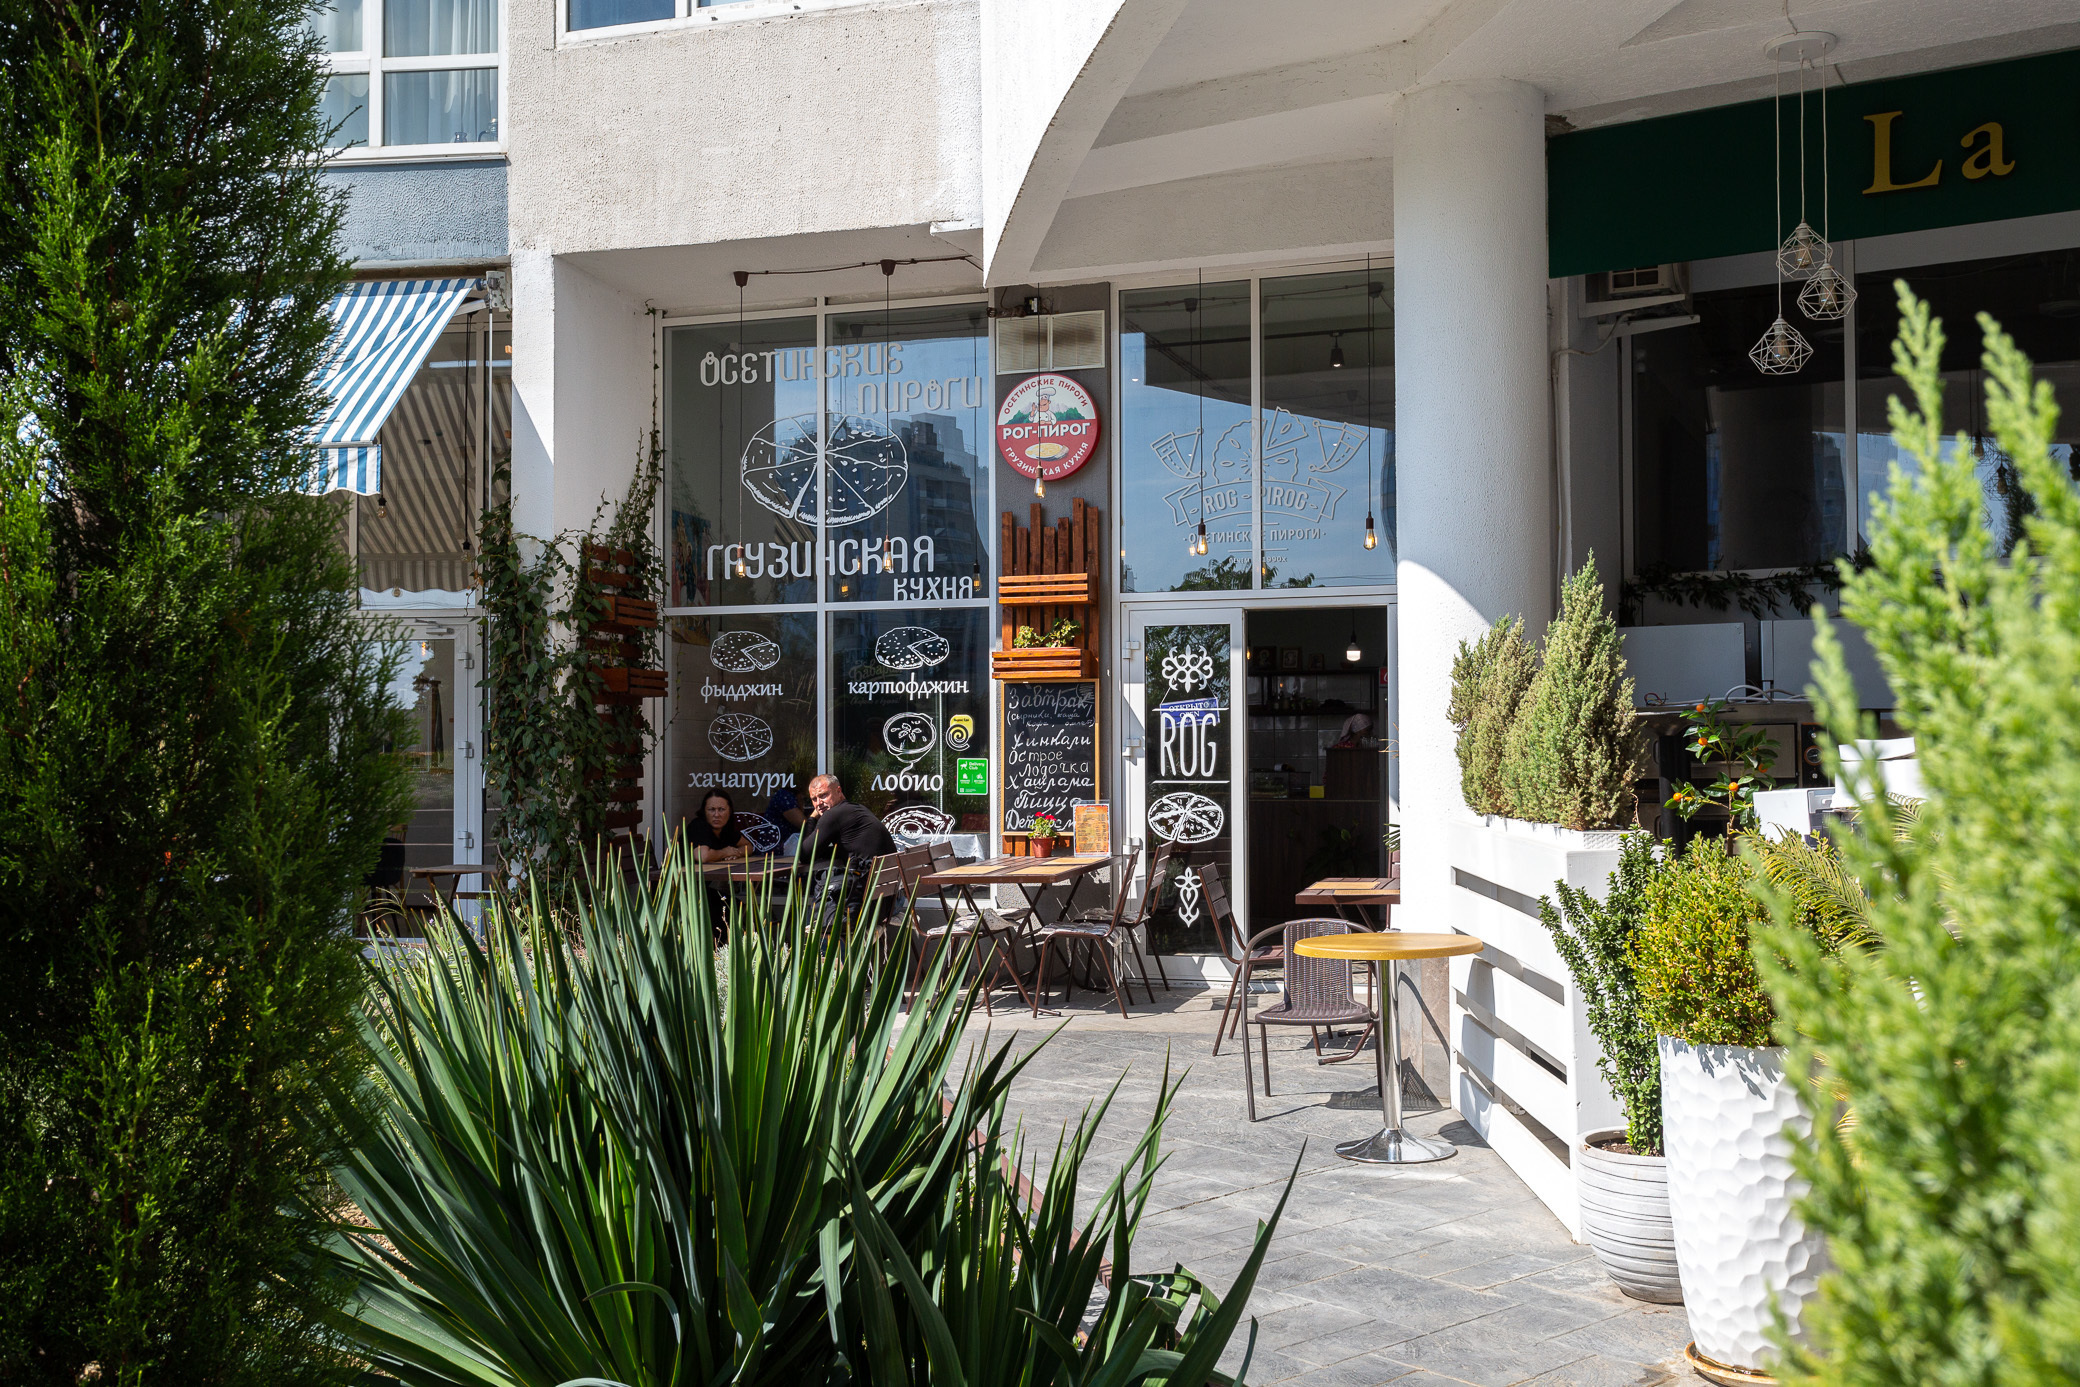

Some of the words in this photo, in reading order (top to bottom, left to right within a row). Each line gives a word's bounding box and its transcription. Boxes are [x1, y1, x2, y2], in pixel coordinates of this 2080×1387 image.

[1862, 110, 2016, 194] La
[700, 341, 904, 387] ОСЕТИНСКИЕ
[857, 375, 983, 415] ПИРОГИ
[1004, 378, 1054, 415] ОСЕТИНСКИЕ
[1058, 380, 1088, 407] ПИРОГИ
[1002, 422, 1091, 440] РОГ-ПИРОГ
[1005, 446, 1061, 476] ГРУЗИНКАЯ
[1063, 441, 1089, 470] КУХНЯ
[1203, 488, 1238, 514] ROG
[1270, 528, 1320, 542] ПИРОГИ
[706, 535, 935, 581] ГРУЗИНСКАЯ
[893, 576, 973, 602] КУХНЯ
[700, 676, 784, 704] фыдджин
[847, 672, 970, 701] картофджин
[1160, 712, 1217, 777] ROG
[687, 773, 797, 797] хачапури
[871, 763, 944, 791] лобио
